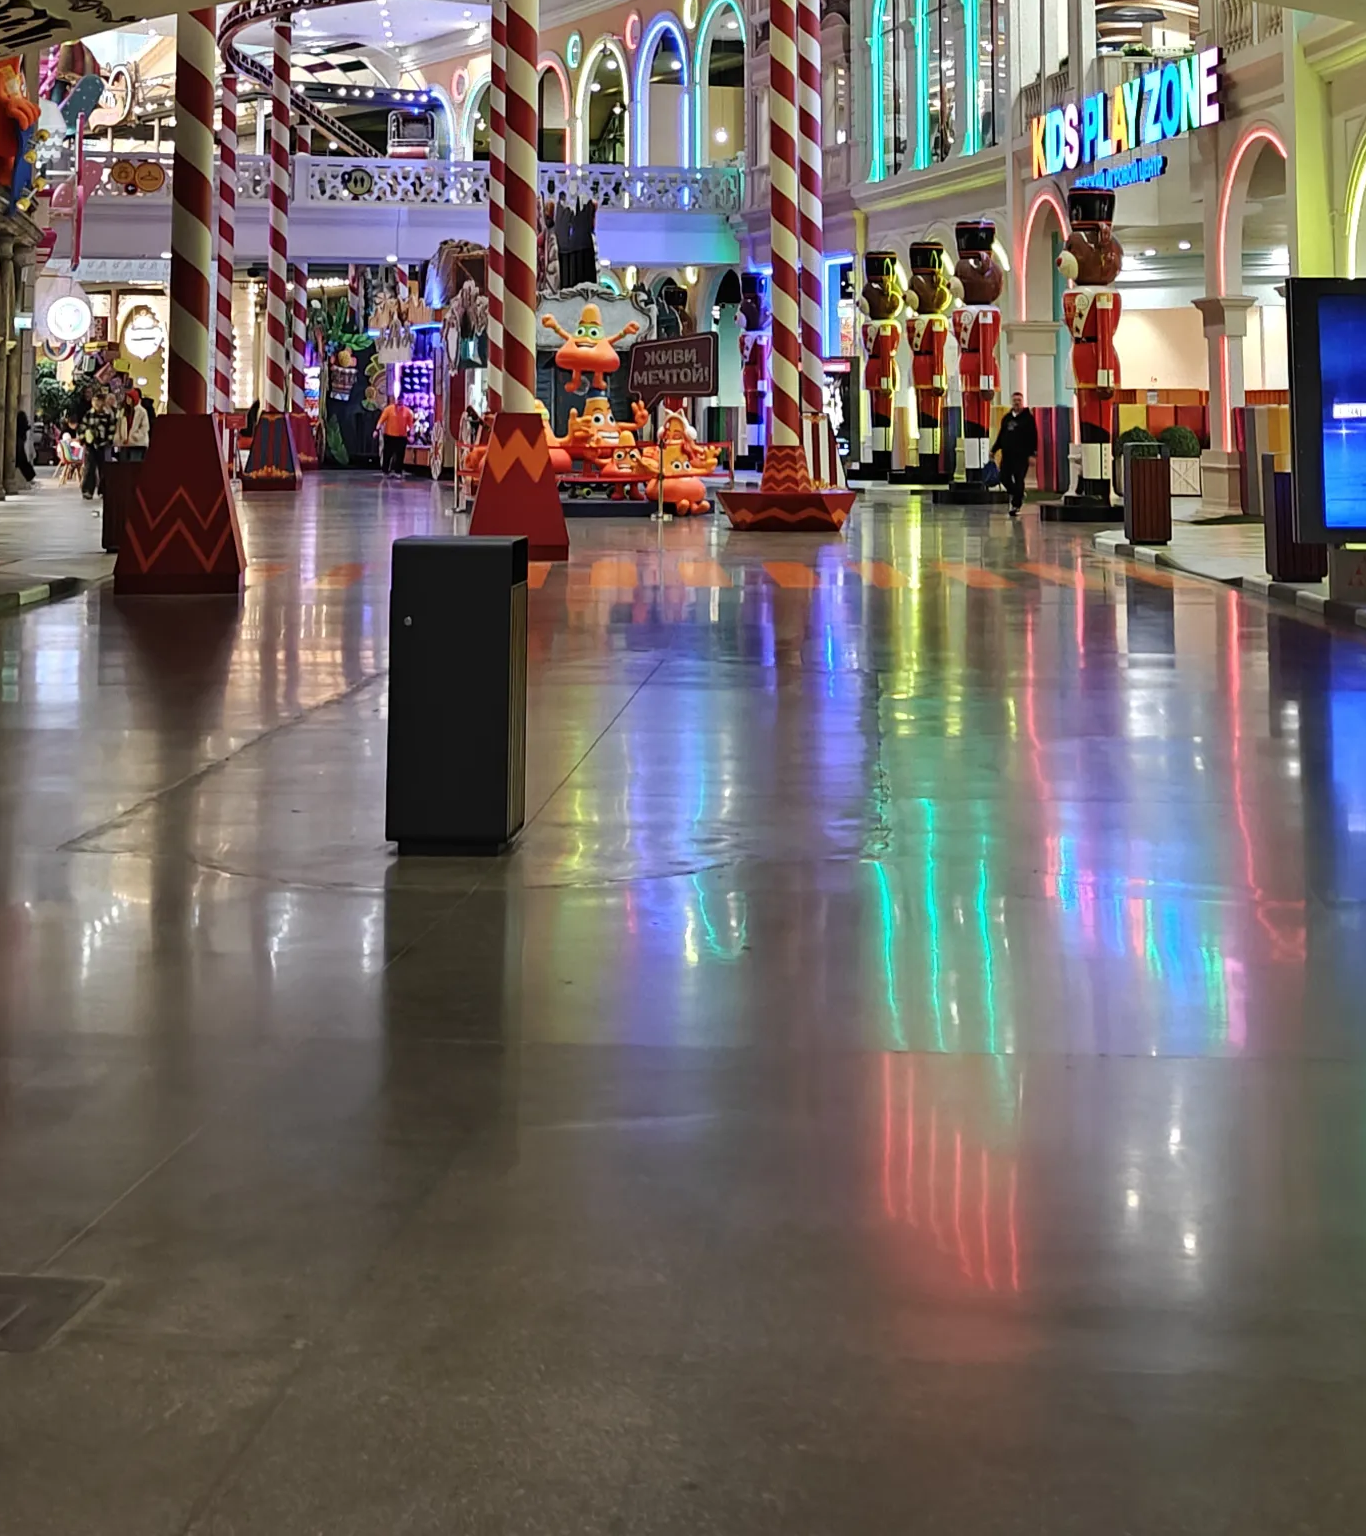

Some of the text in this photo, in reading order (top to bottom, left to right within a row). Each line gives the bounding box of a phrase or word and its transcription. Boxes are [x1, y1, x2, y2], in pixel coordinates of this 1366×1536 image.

[1032, 46, 1221, 180] KIDS PLAY ZONE
[644, 348, 697, 366] ЖИВИ
[633, 362, 710, 386] МЕЧТОЙ!
